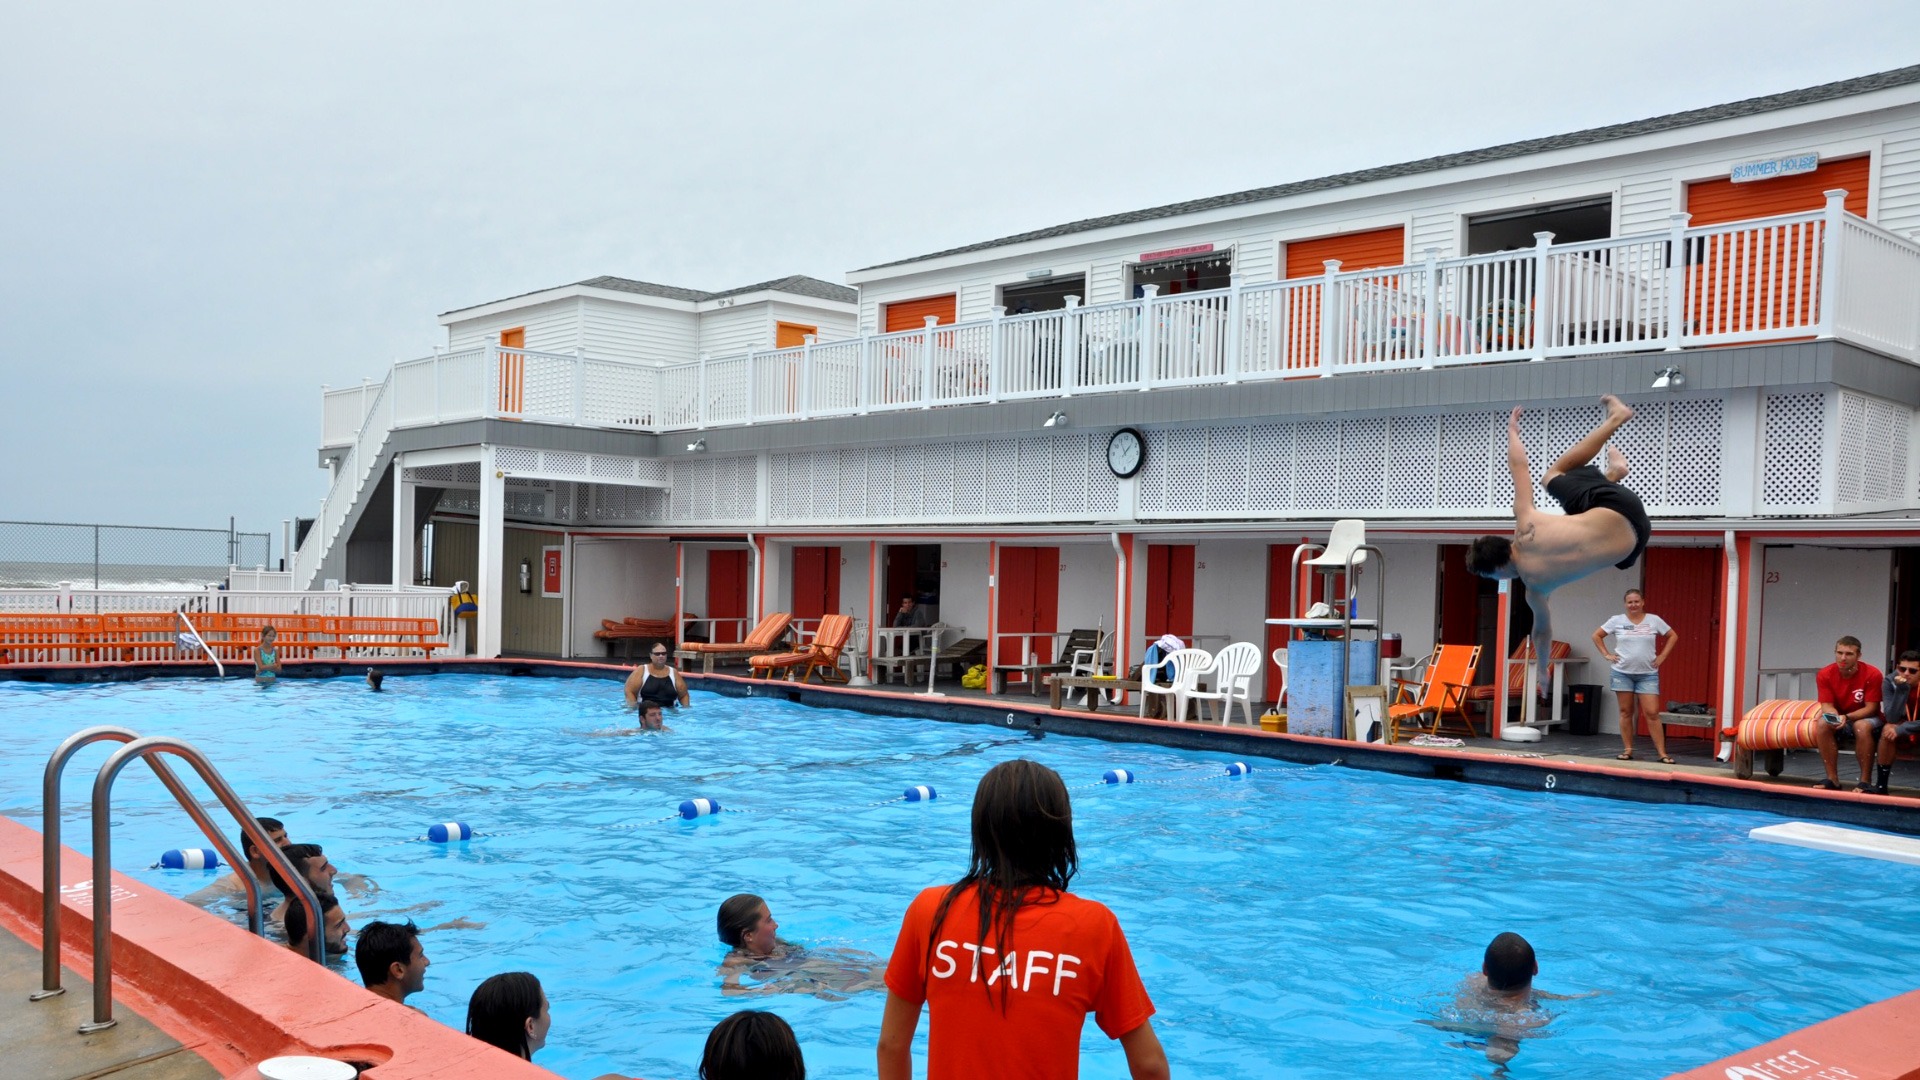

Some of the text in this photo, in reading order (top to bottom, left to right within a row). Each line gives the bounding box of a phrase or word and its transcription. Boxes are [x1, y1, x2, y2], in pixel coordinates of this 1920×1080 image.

[1732, 155, 1817, 179] SUMMER HOUSE
[1197, 561, 1206, 569] 26
[1766, 571, 1780, 584] 23
[746, 685, 752, 696] 3
[1006, 713, 1014, 725] 6
[1545, 774, 1556, 789] 9
[931, 940, 1082, 996] STAFF
[1751, 1049, 1820, 1079] FEET
